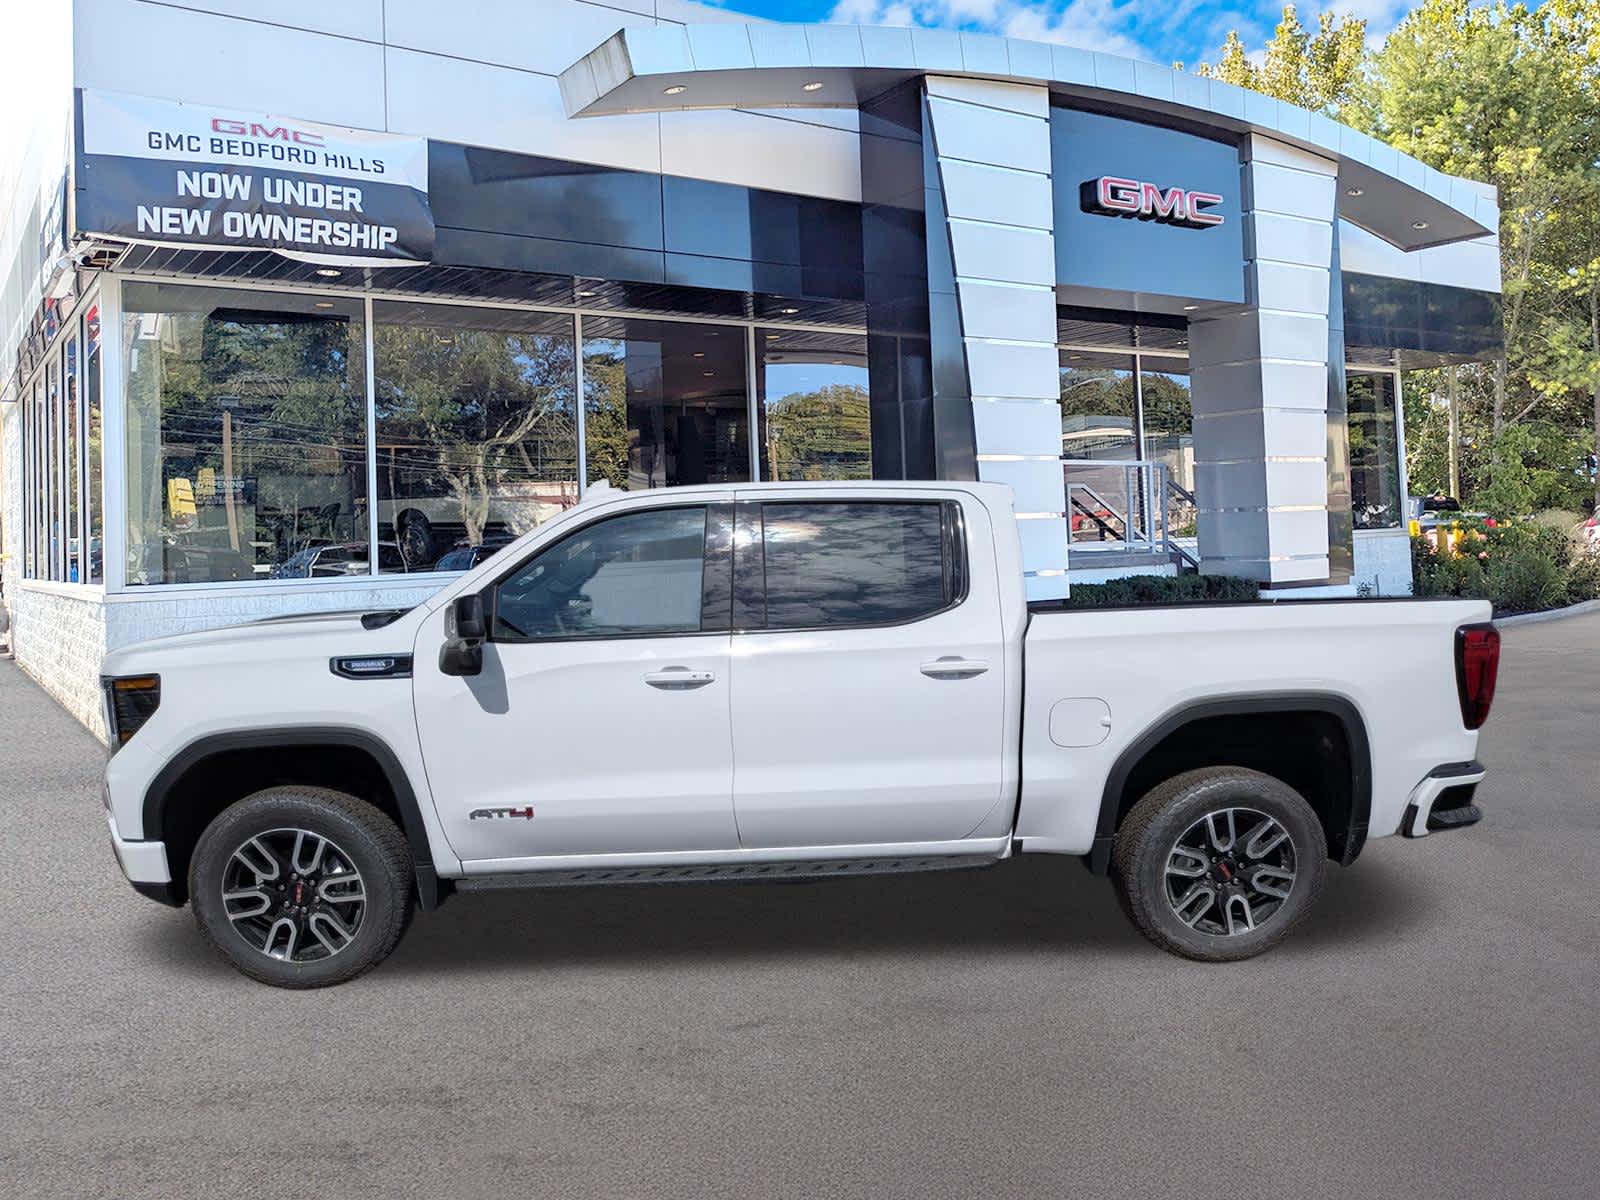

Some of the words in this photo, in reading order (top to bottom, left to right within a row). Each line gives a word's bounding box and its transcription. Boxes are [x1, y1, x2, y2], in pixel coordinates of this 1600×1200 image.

[148, 131, 201, 151] GMC
[210, 138, 316, 165] BEDFORD
[325, 154, 385, 174] HILLS
[211, 118, 325, 147] GMC
[176, 170, 252, 200] NOW
[263, 177, 363, 213] UNDER
[1097, 175, 1225, 225] GMC
[136, 205, 211, 235] NEW
[223, 211, 398, 250] OWNERSHIP
[469, 806, 534, 820] AT4
